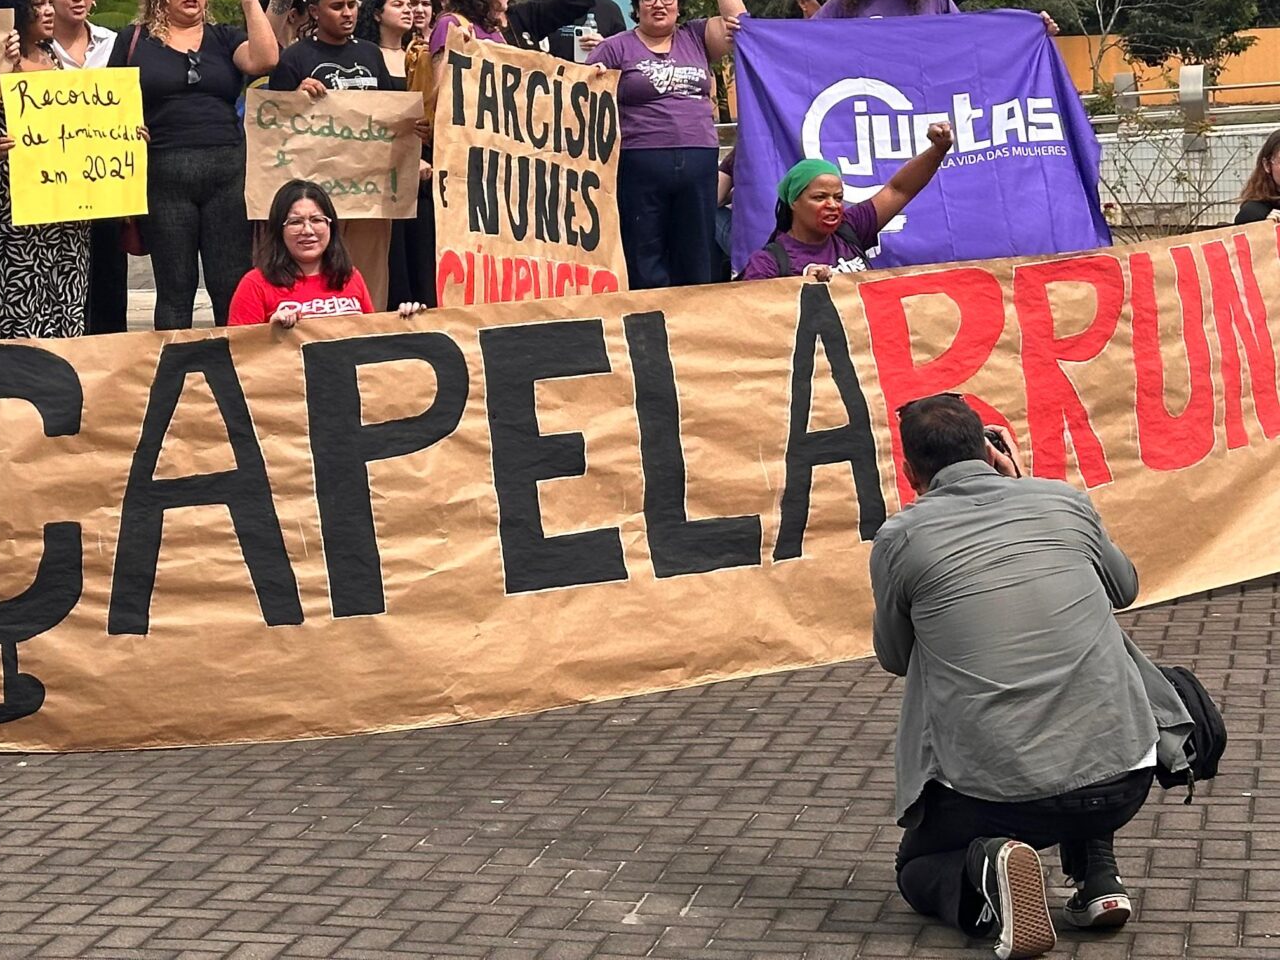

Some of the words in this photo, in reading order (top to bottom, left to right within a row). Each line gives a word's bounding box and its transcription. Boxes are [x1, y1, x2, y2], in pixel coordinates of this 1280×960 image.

[11, 80, 120, 118] Recorde
[22, 125, 49, 147] de
[41, 170, 67, 184] em
[82, 150, 135, 183] 2024
[956, 152, 985, 167] VIDA
[986, 146, 1010, 161] DAS
[1012, 145, 1067, 157] MULHERES
[467, 146, 600, 252] NUNES
[302, 281, 888, 620] PELA
[857, 224, 1280, 510] BRUN
